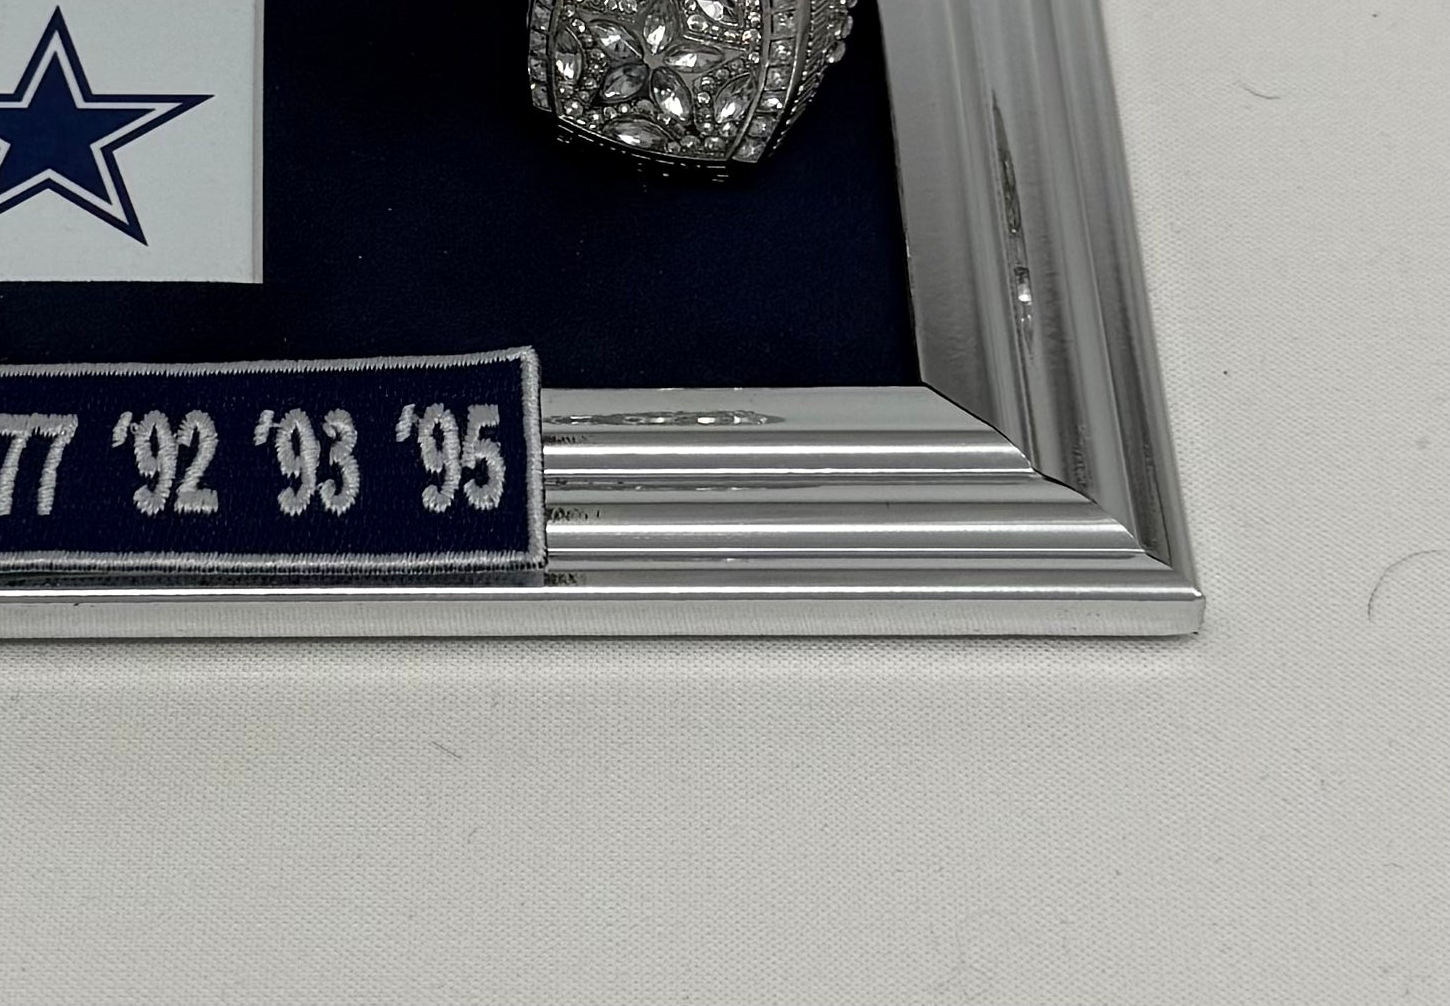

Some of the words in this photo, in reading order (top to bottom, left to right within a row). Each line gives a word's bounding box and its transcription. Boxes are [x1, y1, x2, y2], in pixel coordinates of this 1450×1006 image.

[112, 409, 219, 516] '92
[254, 407, 361, 517] '93
[396, 402, 507, 513] '95
